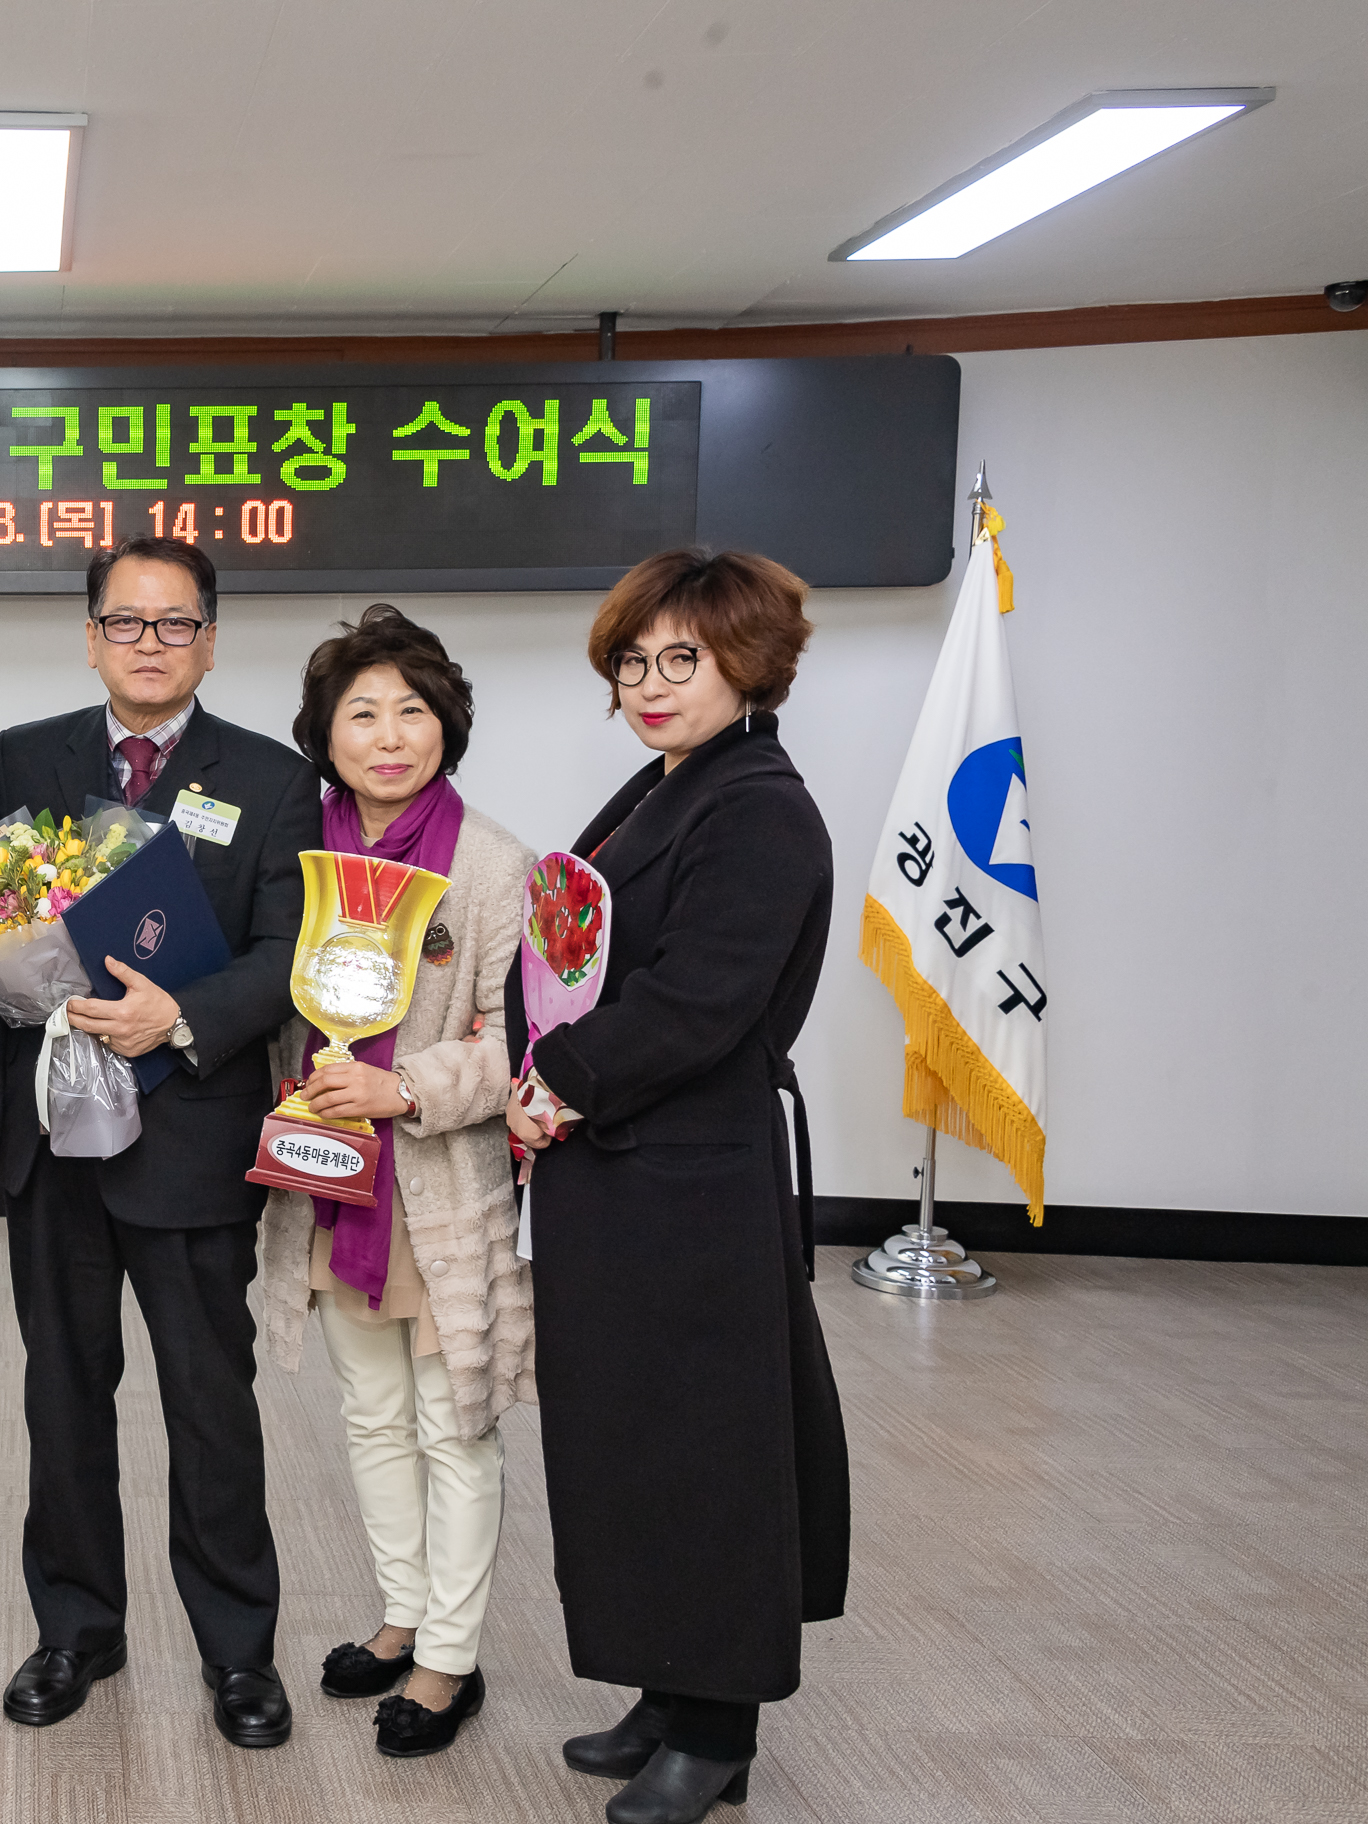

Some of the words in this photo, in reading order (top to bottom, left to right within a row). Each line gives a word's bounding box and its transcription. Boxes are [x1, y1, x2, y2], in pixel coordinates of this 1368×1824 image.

[9, 402, 357, 491] 구민표창
[392, 398, 651, 488] 수여식
[276, 1139, 360, 1172] 중곡4동마을계획단
